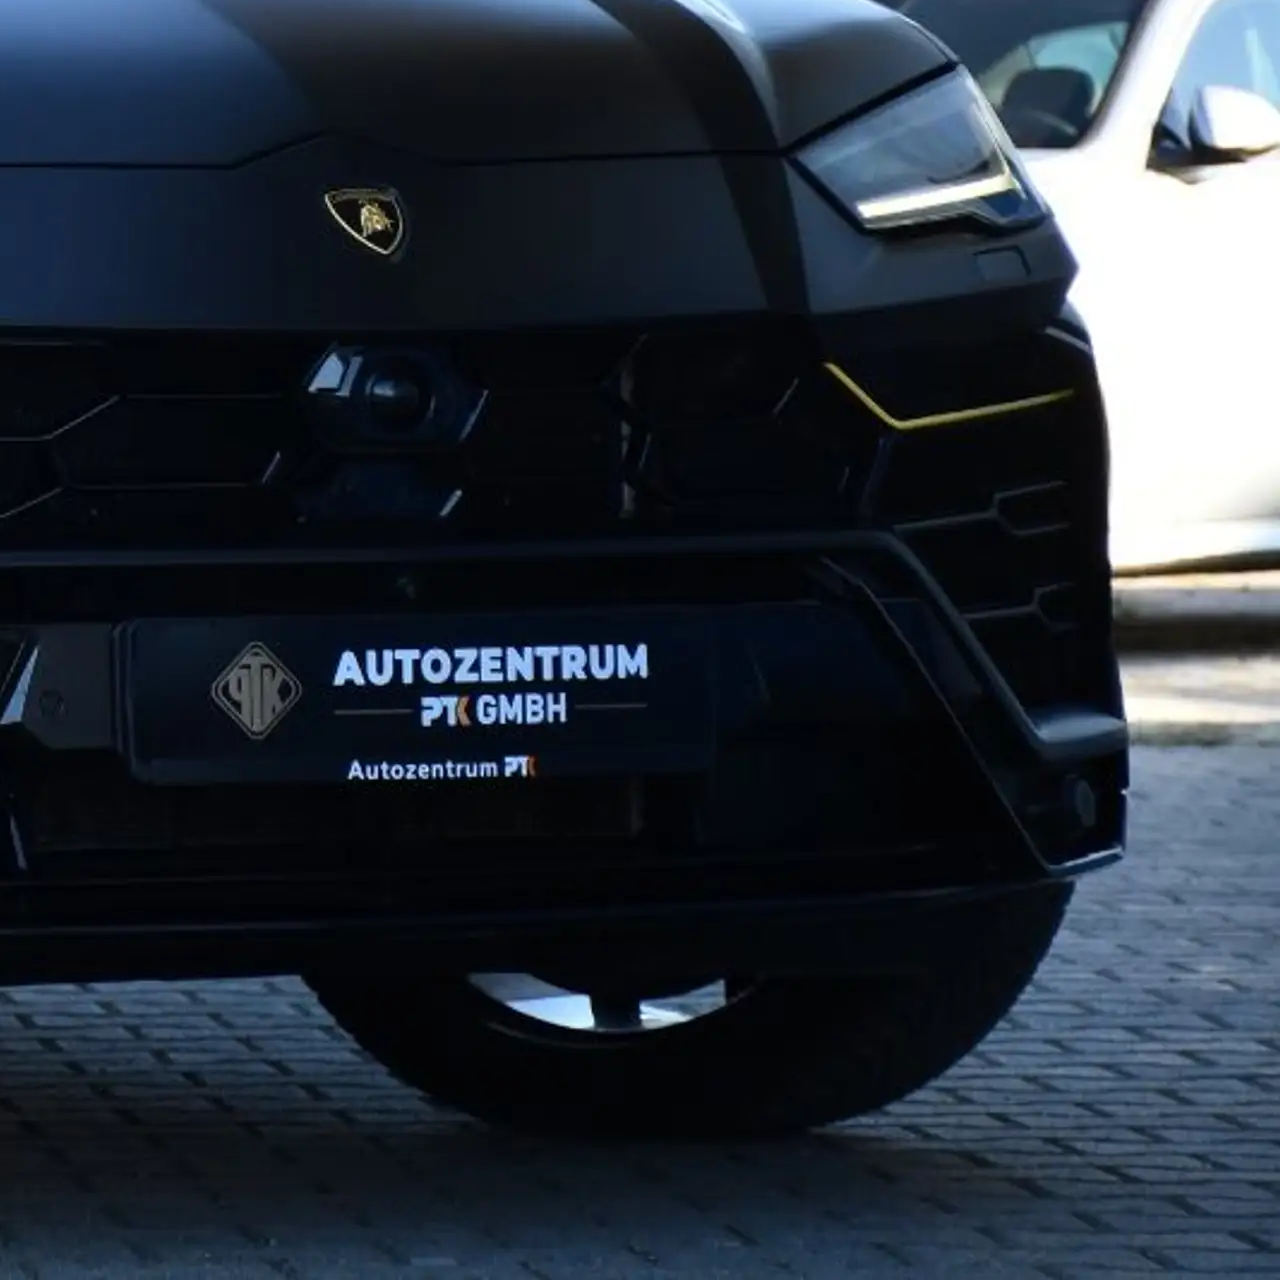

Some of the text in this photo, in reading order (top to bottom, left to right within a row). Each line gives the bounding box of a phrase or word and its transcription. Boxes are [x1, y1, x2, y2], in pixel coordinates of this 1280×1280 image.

[333, 644, 649, 686] AUTOZENTRUM
[476, 692, 567, 725] GMBH
[347, 758, 499, 781] Autozentrum
